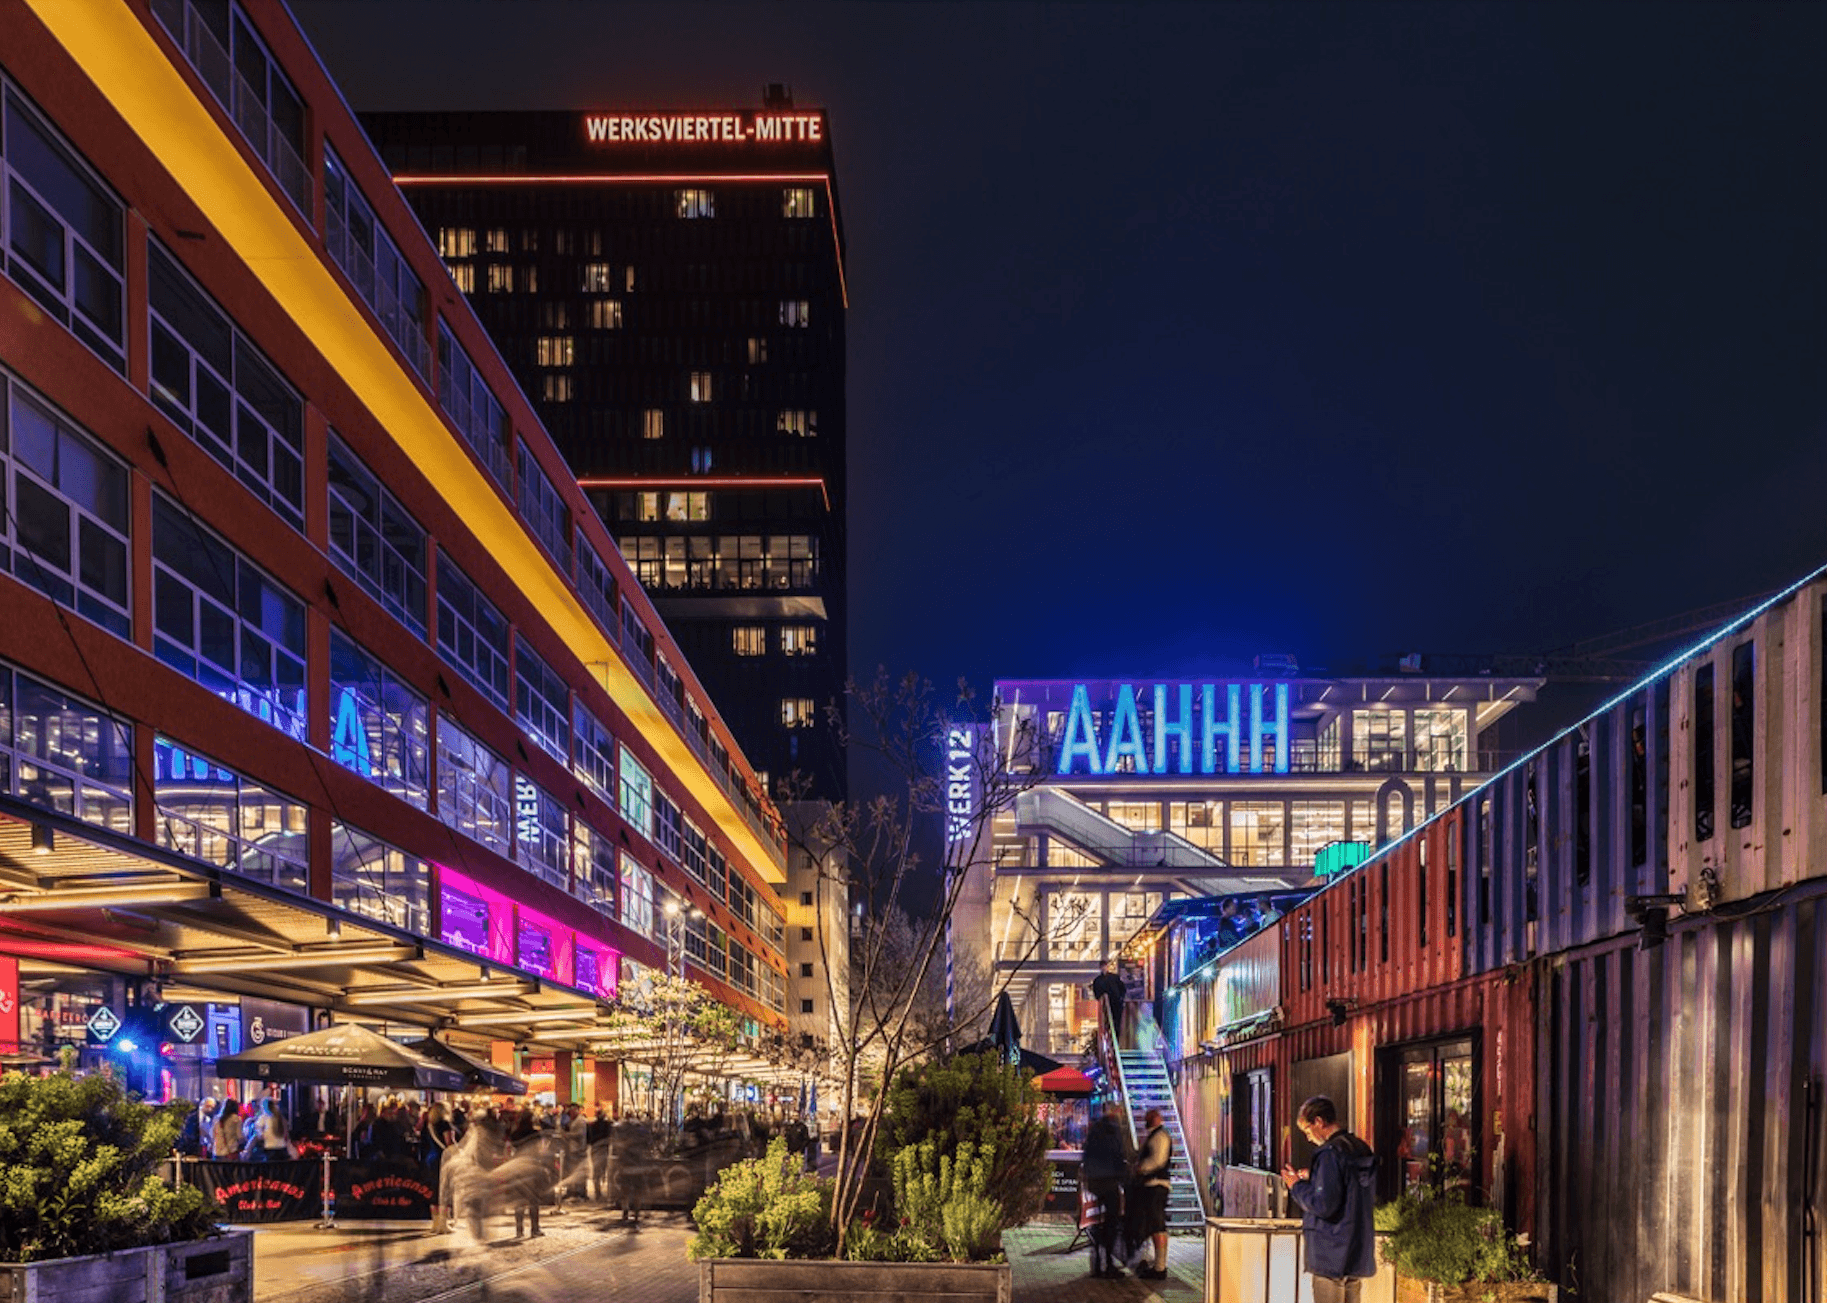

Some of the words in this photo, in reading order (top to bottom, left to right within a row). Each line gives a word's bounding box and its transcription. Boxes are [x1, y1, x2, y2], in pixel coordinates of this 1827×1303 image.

[586, 116, 821, 141] WERKSVIERTEL-MITTE
[1057, 684, 1289, 774] AAHHH
[948, 730, 972, 760] 12
[948, 764, 972, 842] WERK
[215, 1176, 305, 1205] Americanos
